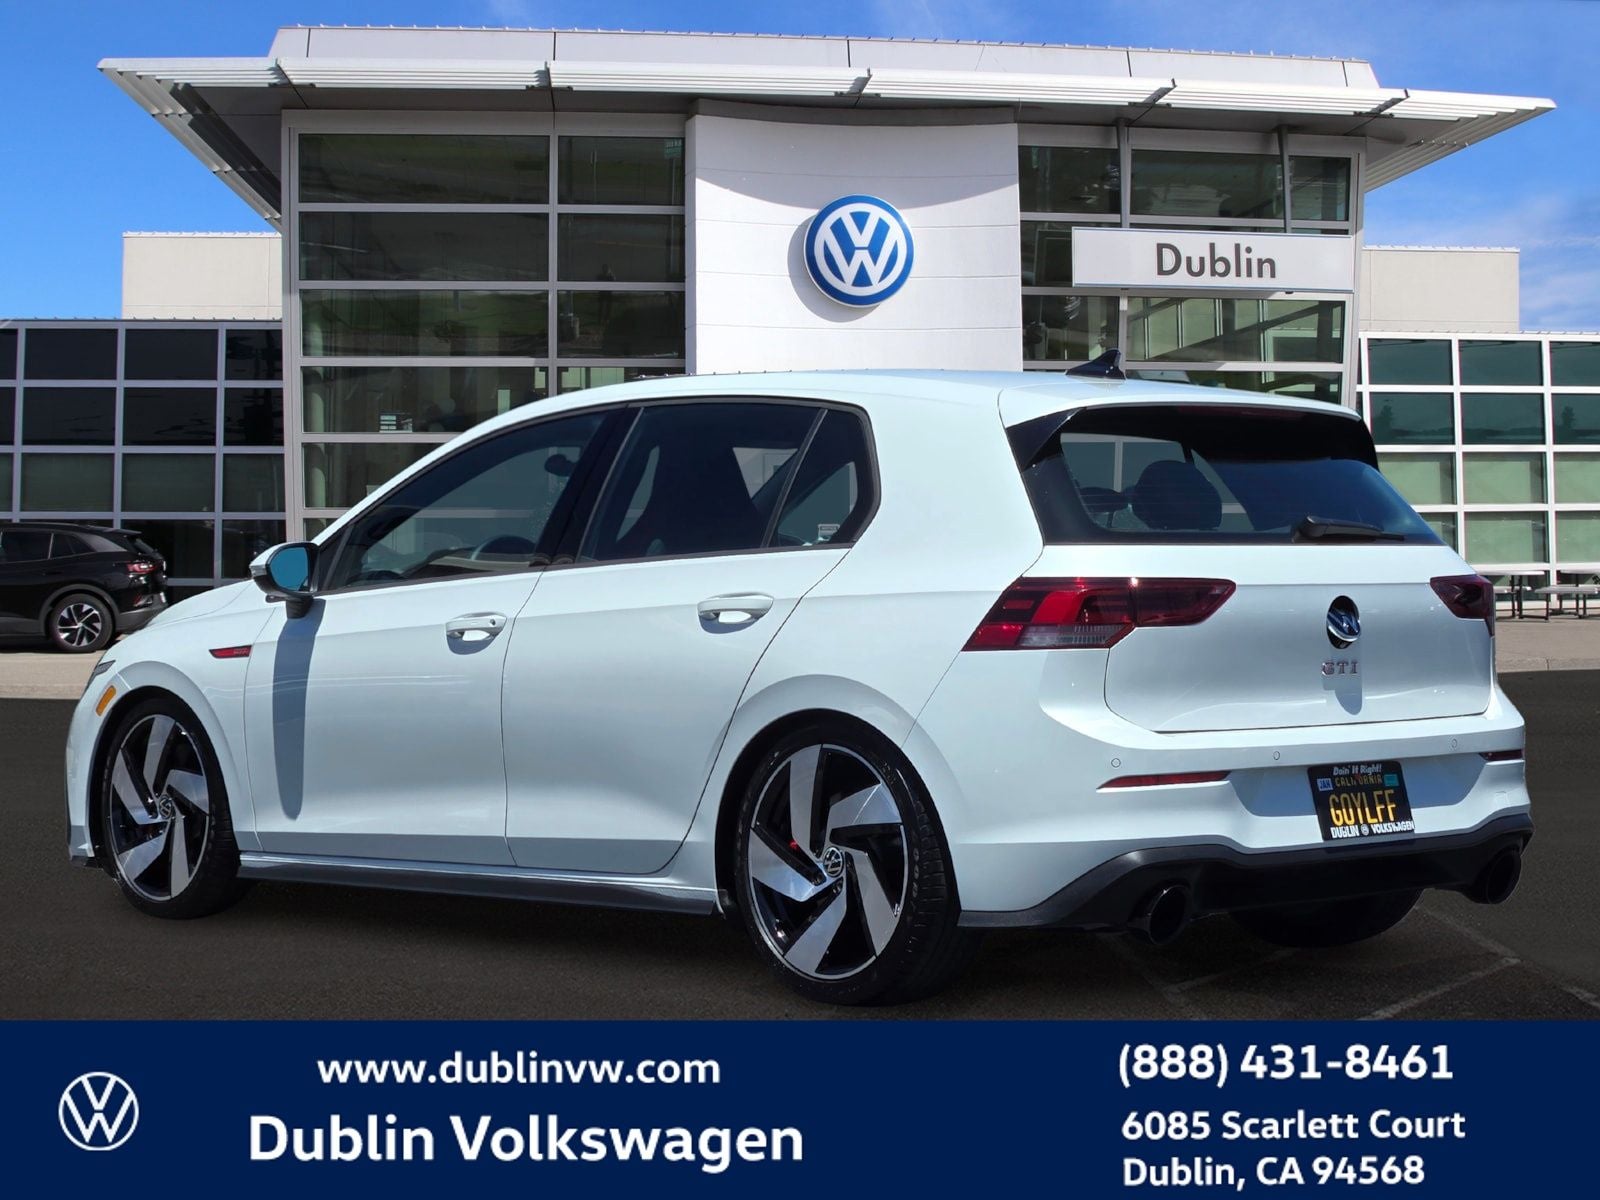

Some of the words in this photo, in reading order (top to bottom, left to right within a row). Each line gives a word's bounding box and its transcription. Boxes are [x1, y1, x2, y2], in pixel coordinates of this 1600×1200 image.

[813, 202, 908, 297] VW
[1156, 242, 1277, 279] Dublin
[1321, 661, 1359, 675] GTI
[1335, 774, 1382, 787] CALIORNIA
[1329, 789, 1396, 826] GOYLFF
[1330, 824, 1360, 838] DUBLIN
[1371, 820, 1416, 835] VOLKSWAGEN
